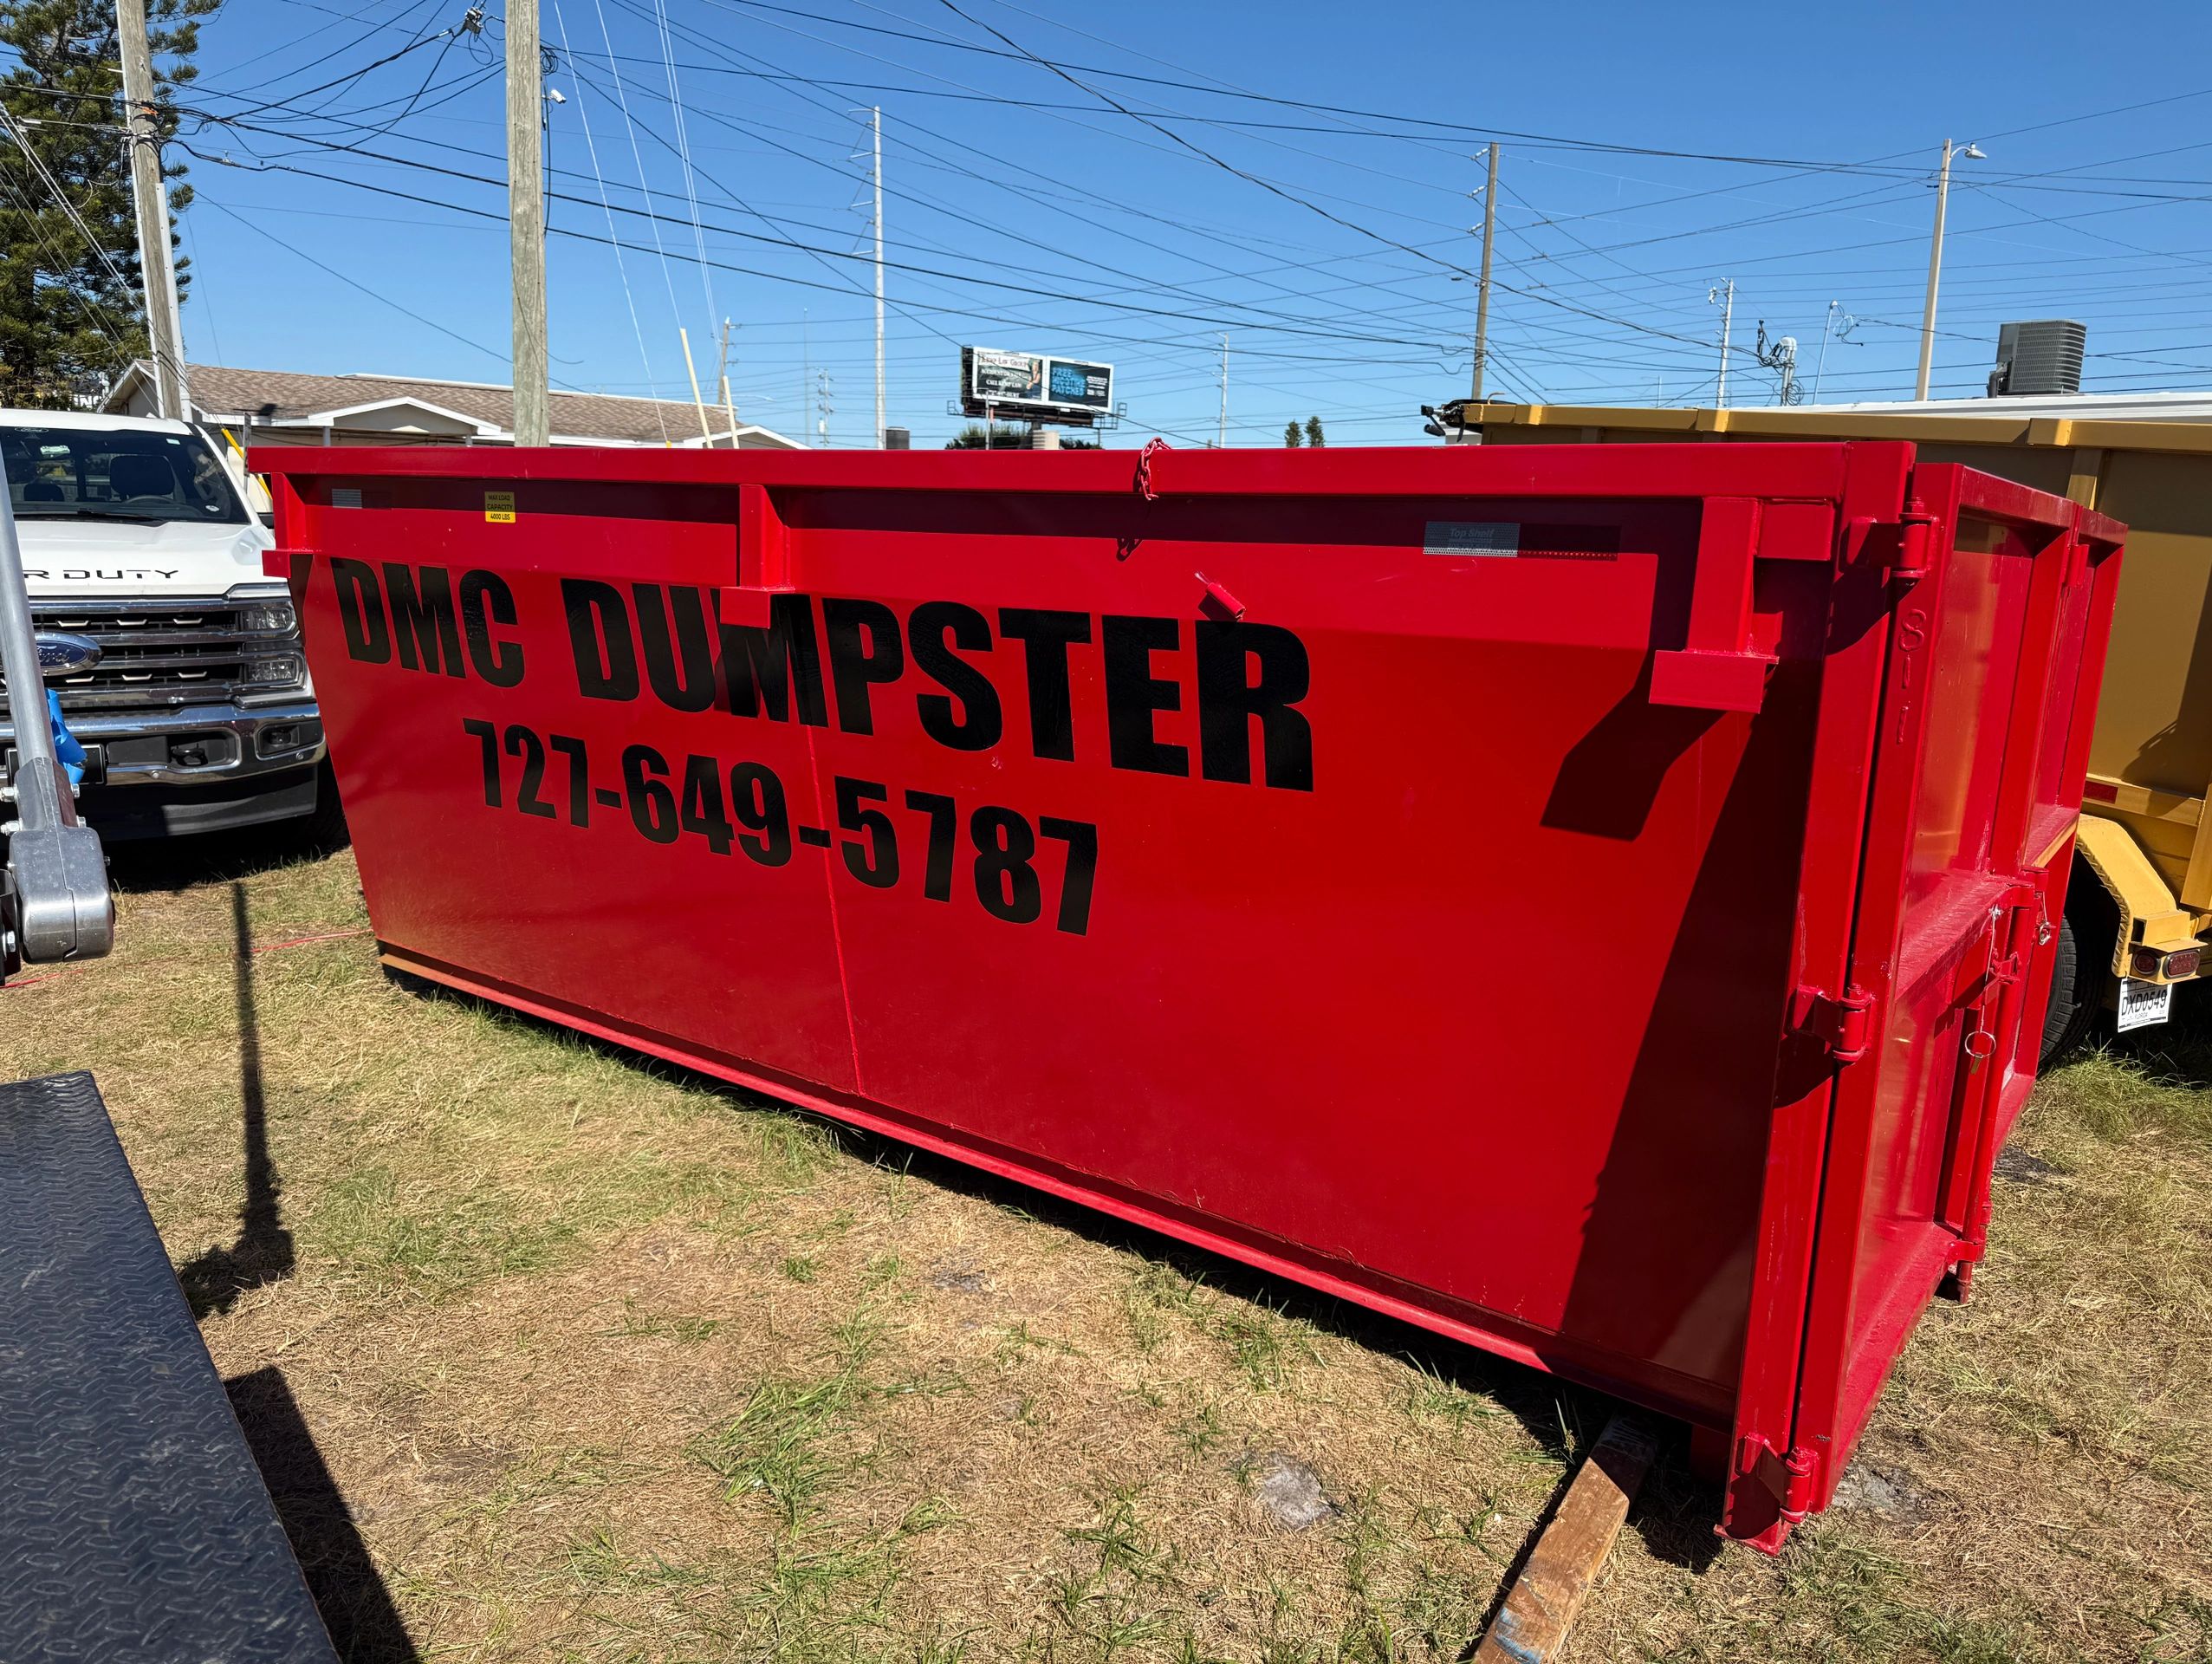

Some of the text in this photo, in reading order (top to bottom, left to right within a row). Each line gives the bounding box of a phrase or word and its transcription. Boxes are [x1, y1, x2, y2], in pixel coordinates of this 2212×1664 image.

[1052, 367, 1073, 379] FREE
[1052, 384, 1084, 396] PATCHES
[63, 569, 178, 580] DUTY
[330, 557, 1314, 793] DMC DUMPSTER
[463, 718, 1098, 937] 727-649-5787
[2121, 989, 2167, 1017] DXD0549
